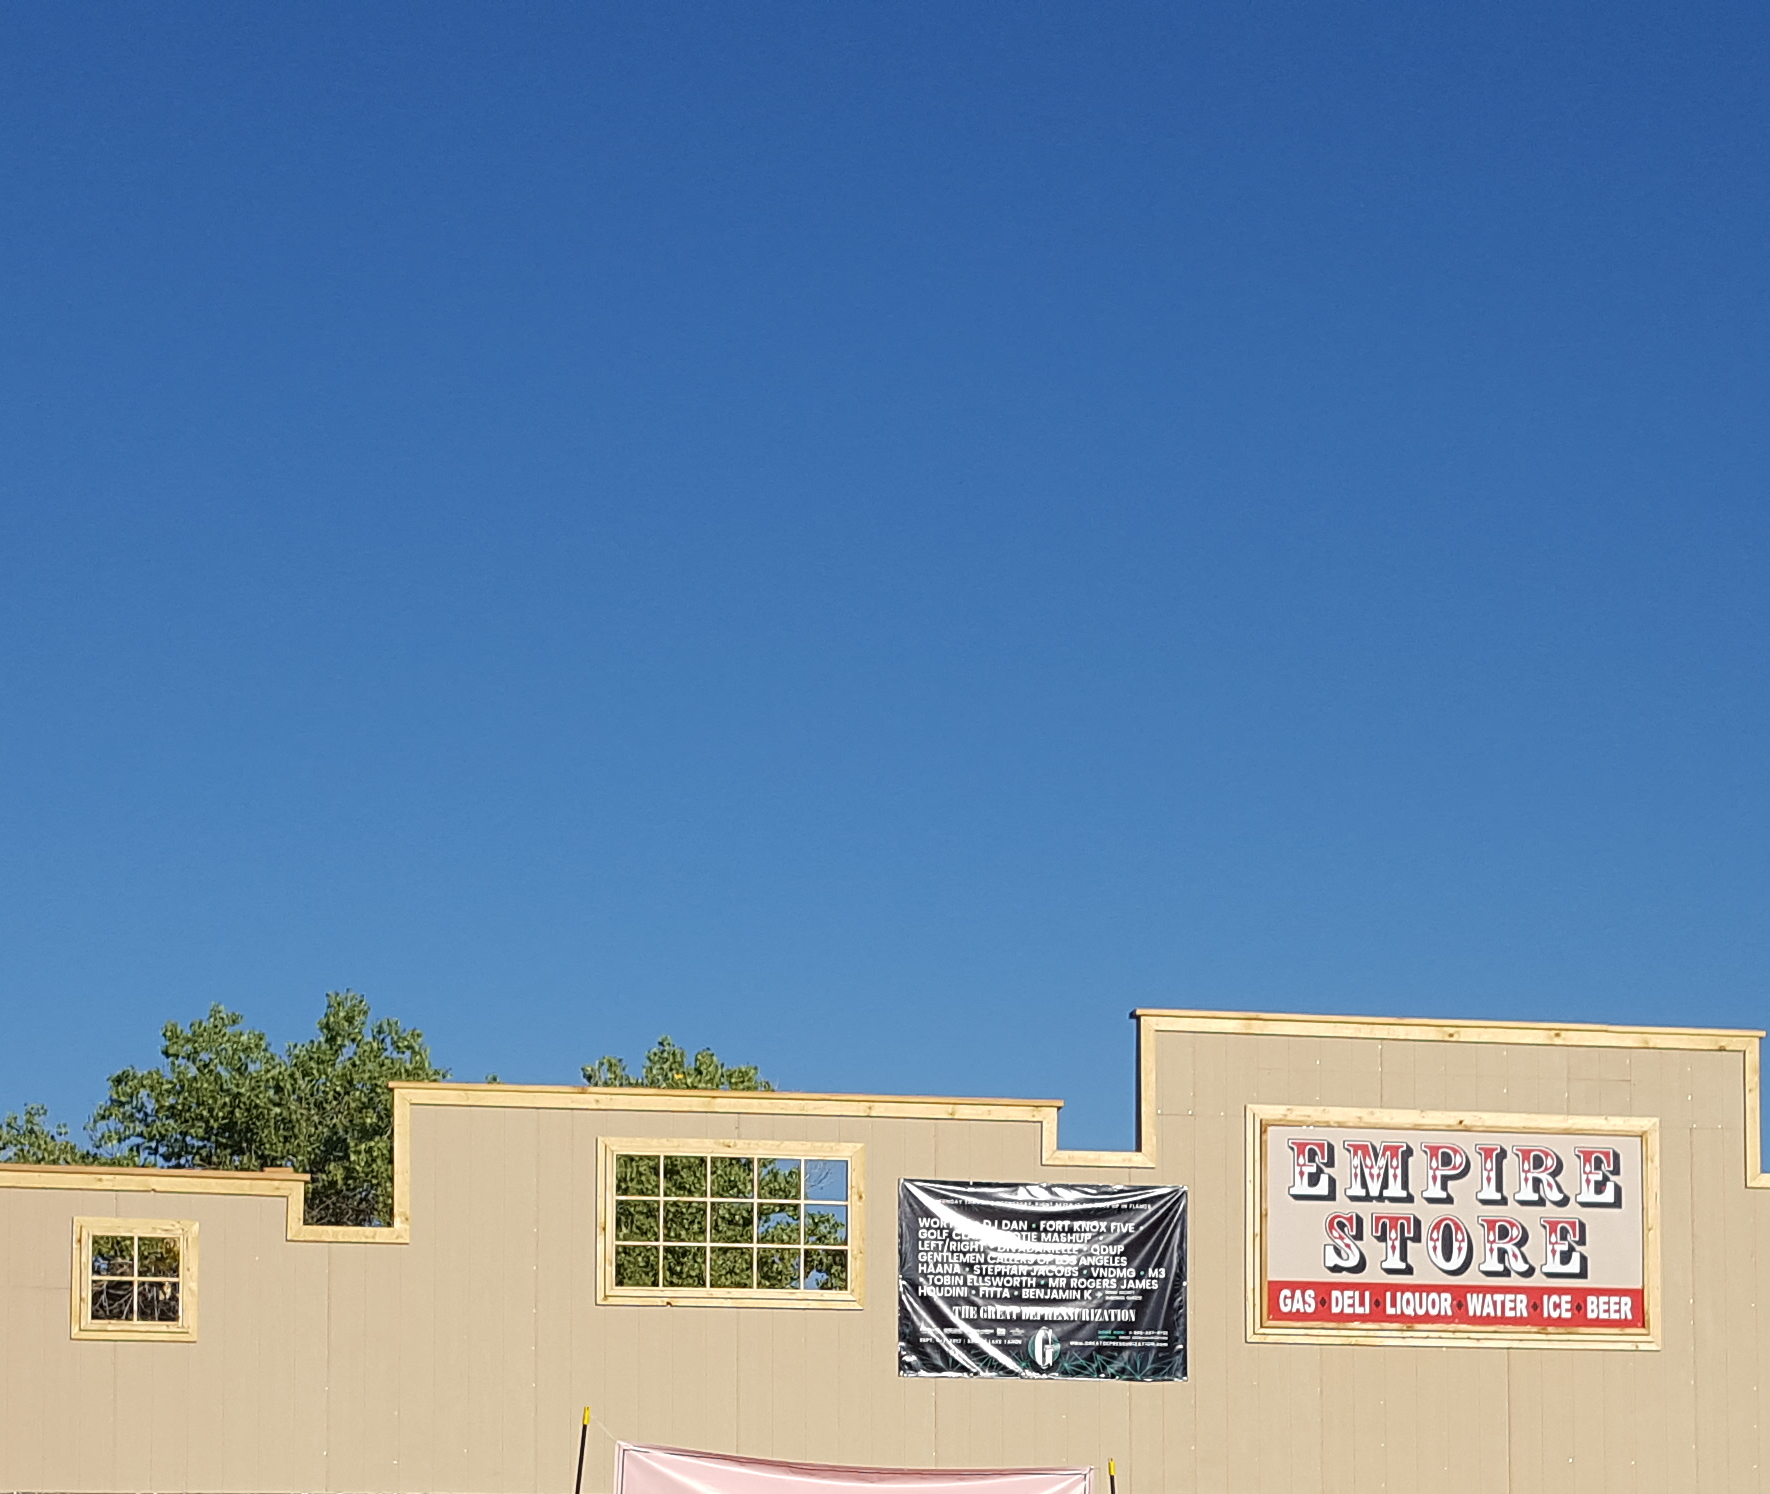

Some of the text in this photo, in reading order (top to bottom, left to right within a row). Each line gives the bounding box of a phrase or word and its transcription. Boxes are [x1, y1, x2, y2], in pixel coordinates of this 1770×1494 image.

[1288, 1138, 1622, 1208] EMPIRE
[1002, 1221, 1028, 1231] DAN
[1040, 1220, 1071, 1232] FORT
[1073, 1221, 1107, 1233] KNOX
[1110, 1222, 1135, 1233] FIVE
[918, 1229, 949, 1240] GOLF
[1041, 1232, 1092, 1243] MASHUP
[918, 1239, 984, 1253] LEFT/RIGHT
[1090, 1245, 1124, 1255] QDUP
[1324, 1212, 1588, 1279] STORE
[918, 1252, 985, 1263] GENTLEMEN
[1079, 1256, 1127, 1266] ANGELES
[973, 1265, 1027, 1275] STEPHAN
[1031, 1266, 1078, 1277] JACOBS
[1091, 1267, 1136, 1278] VNDMG
[1148, 1268, 1166, 1278] M3
[927, 1275, 1158, 1289] TOBIN ELLSWORTH MR ROGERS JAMES
[918, 1286, 968, 1298] HOUDINI
[979, 1288, 1010, 1298] FITTA
[1021, 1288, 1081, 1300] BENJAMIN
[1084, 1290, 1093, 1300] K
[1279, 1289, 1632, 1320] GAS DELI LIQUOR WATER ICE BEER
[952, 1305, 978, 1319] THE
